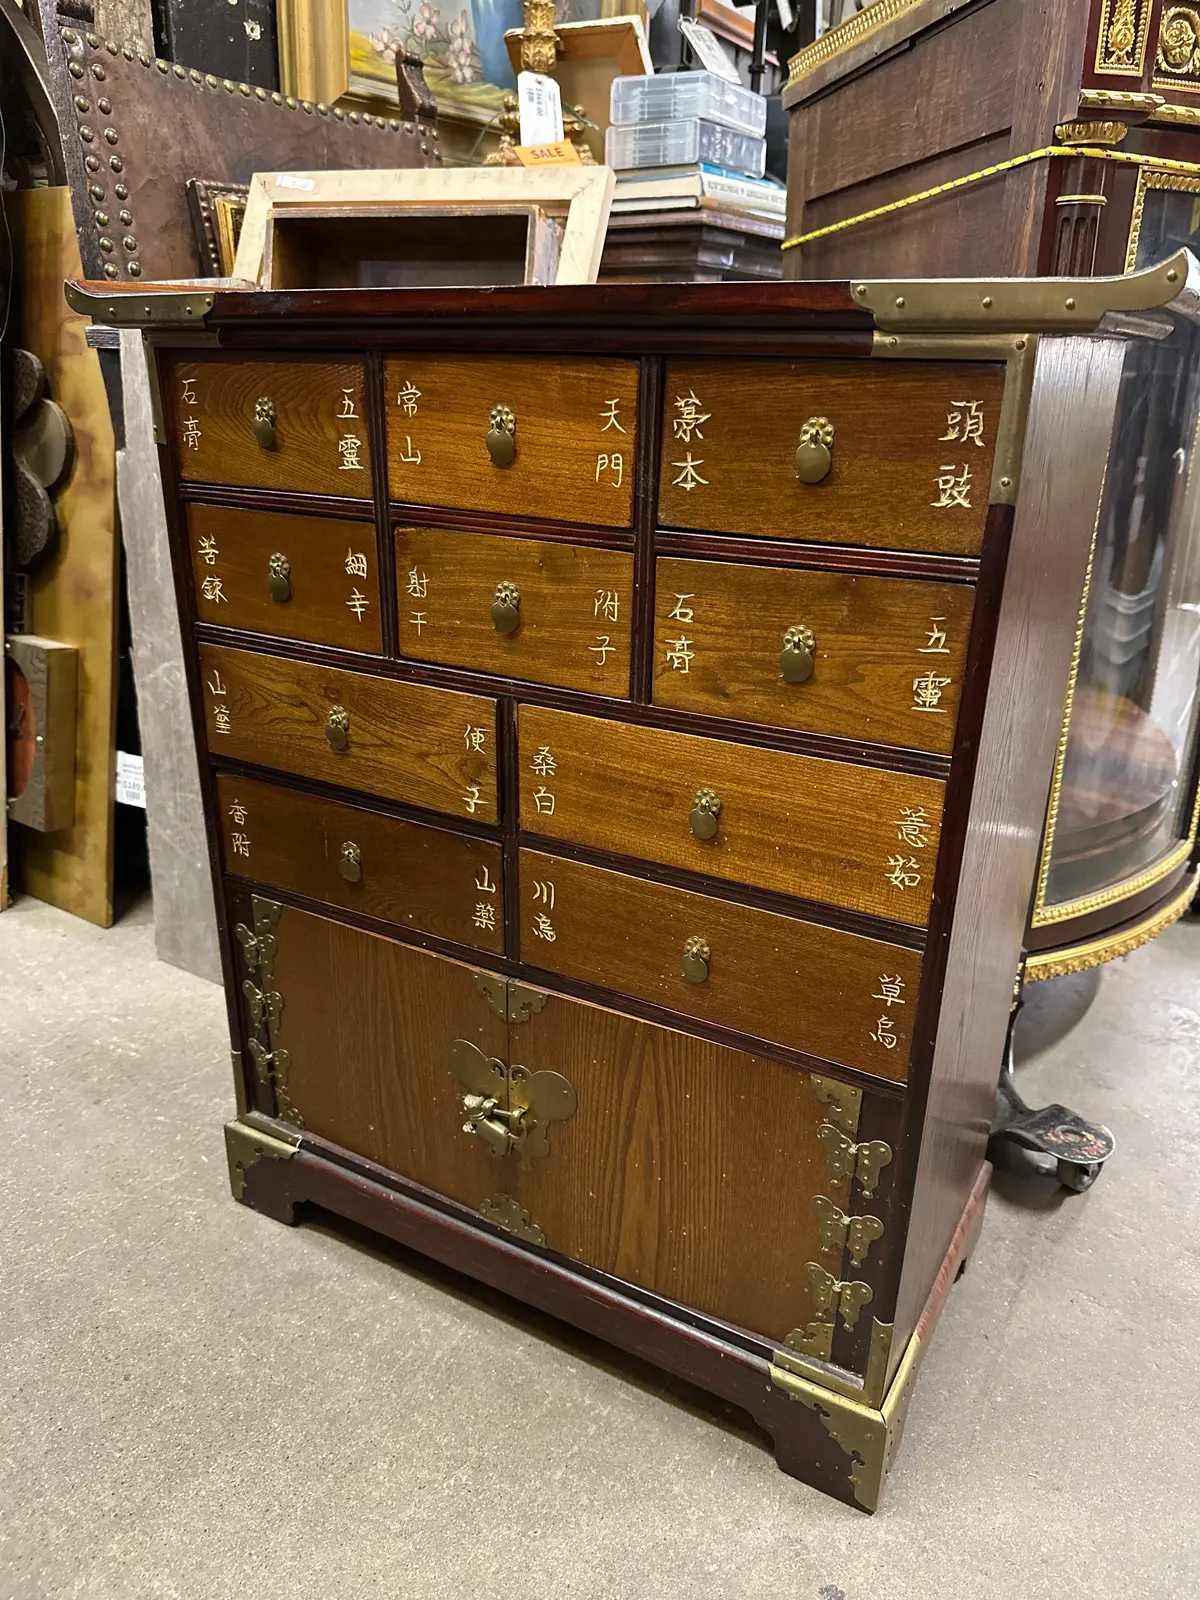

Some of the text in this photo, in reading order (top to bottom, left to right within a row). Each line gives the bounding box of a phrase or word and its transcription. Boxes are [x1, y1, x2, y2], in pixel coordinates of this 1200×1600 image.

[530, 147, 565, 160] SALE
[181, 378, 203, 451] 石膏
[392, 380, 423, 468] 常山
[595, 397, 631, 489] 天門
[587, 589, 621, 666] 附子
[659, 592, 696, 674] 石膏
[526, 745, 558, 818] 桑白
[228, 798, 252, 858] 香附
